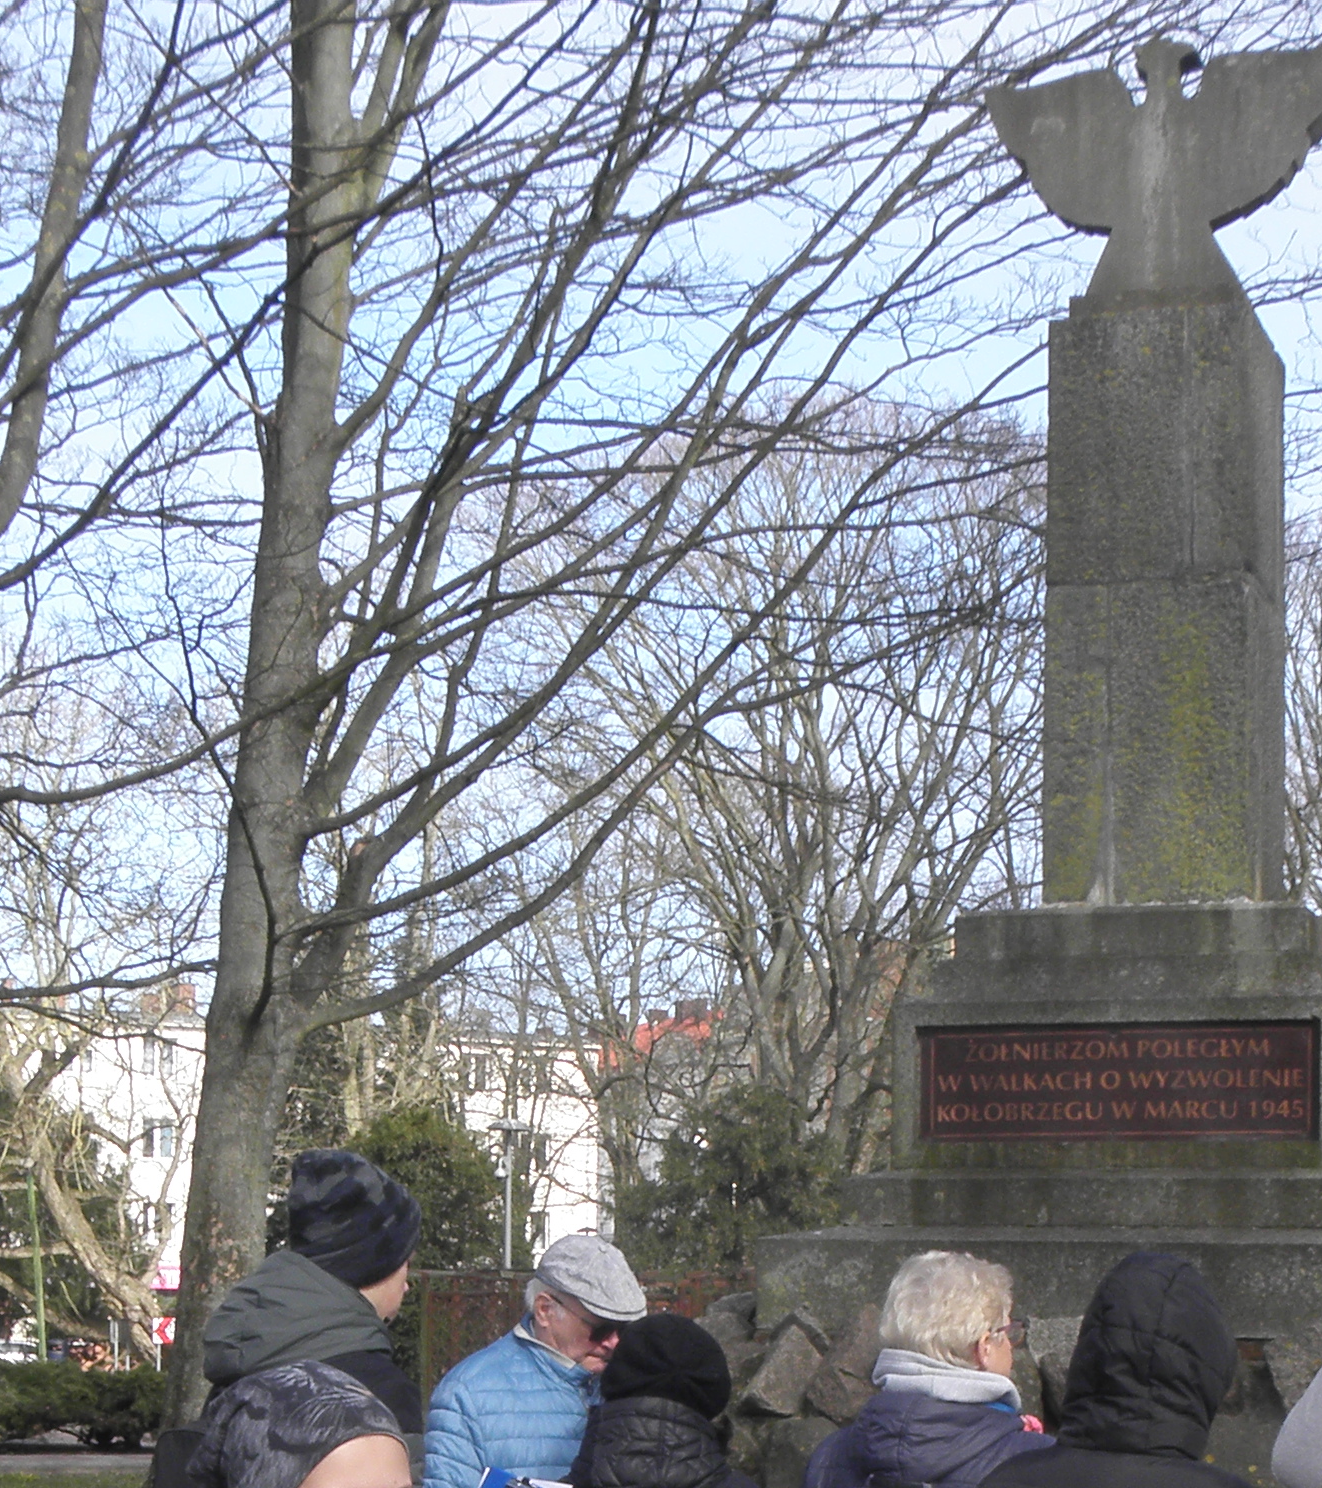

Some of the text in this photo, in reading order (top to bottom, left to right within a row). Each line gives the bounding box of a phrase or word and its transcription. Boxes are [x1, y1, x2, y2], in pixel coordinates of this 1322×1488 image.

[965, 1038, 1271, 1062] ŻOŁNIERZOM POLEGŁYM
[937, 1068, 1304, 1092] W WALKACH O WYZWOLENIE
[937, 1100, 1304, 1122] KOŁOBRZEGU W MARCU 1945
